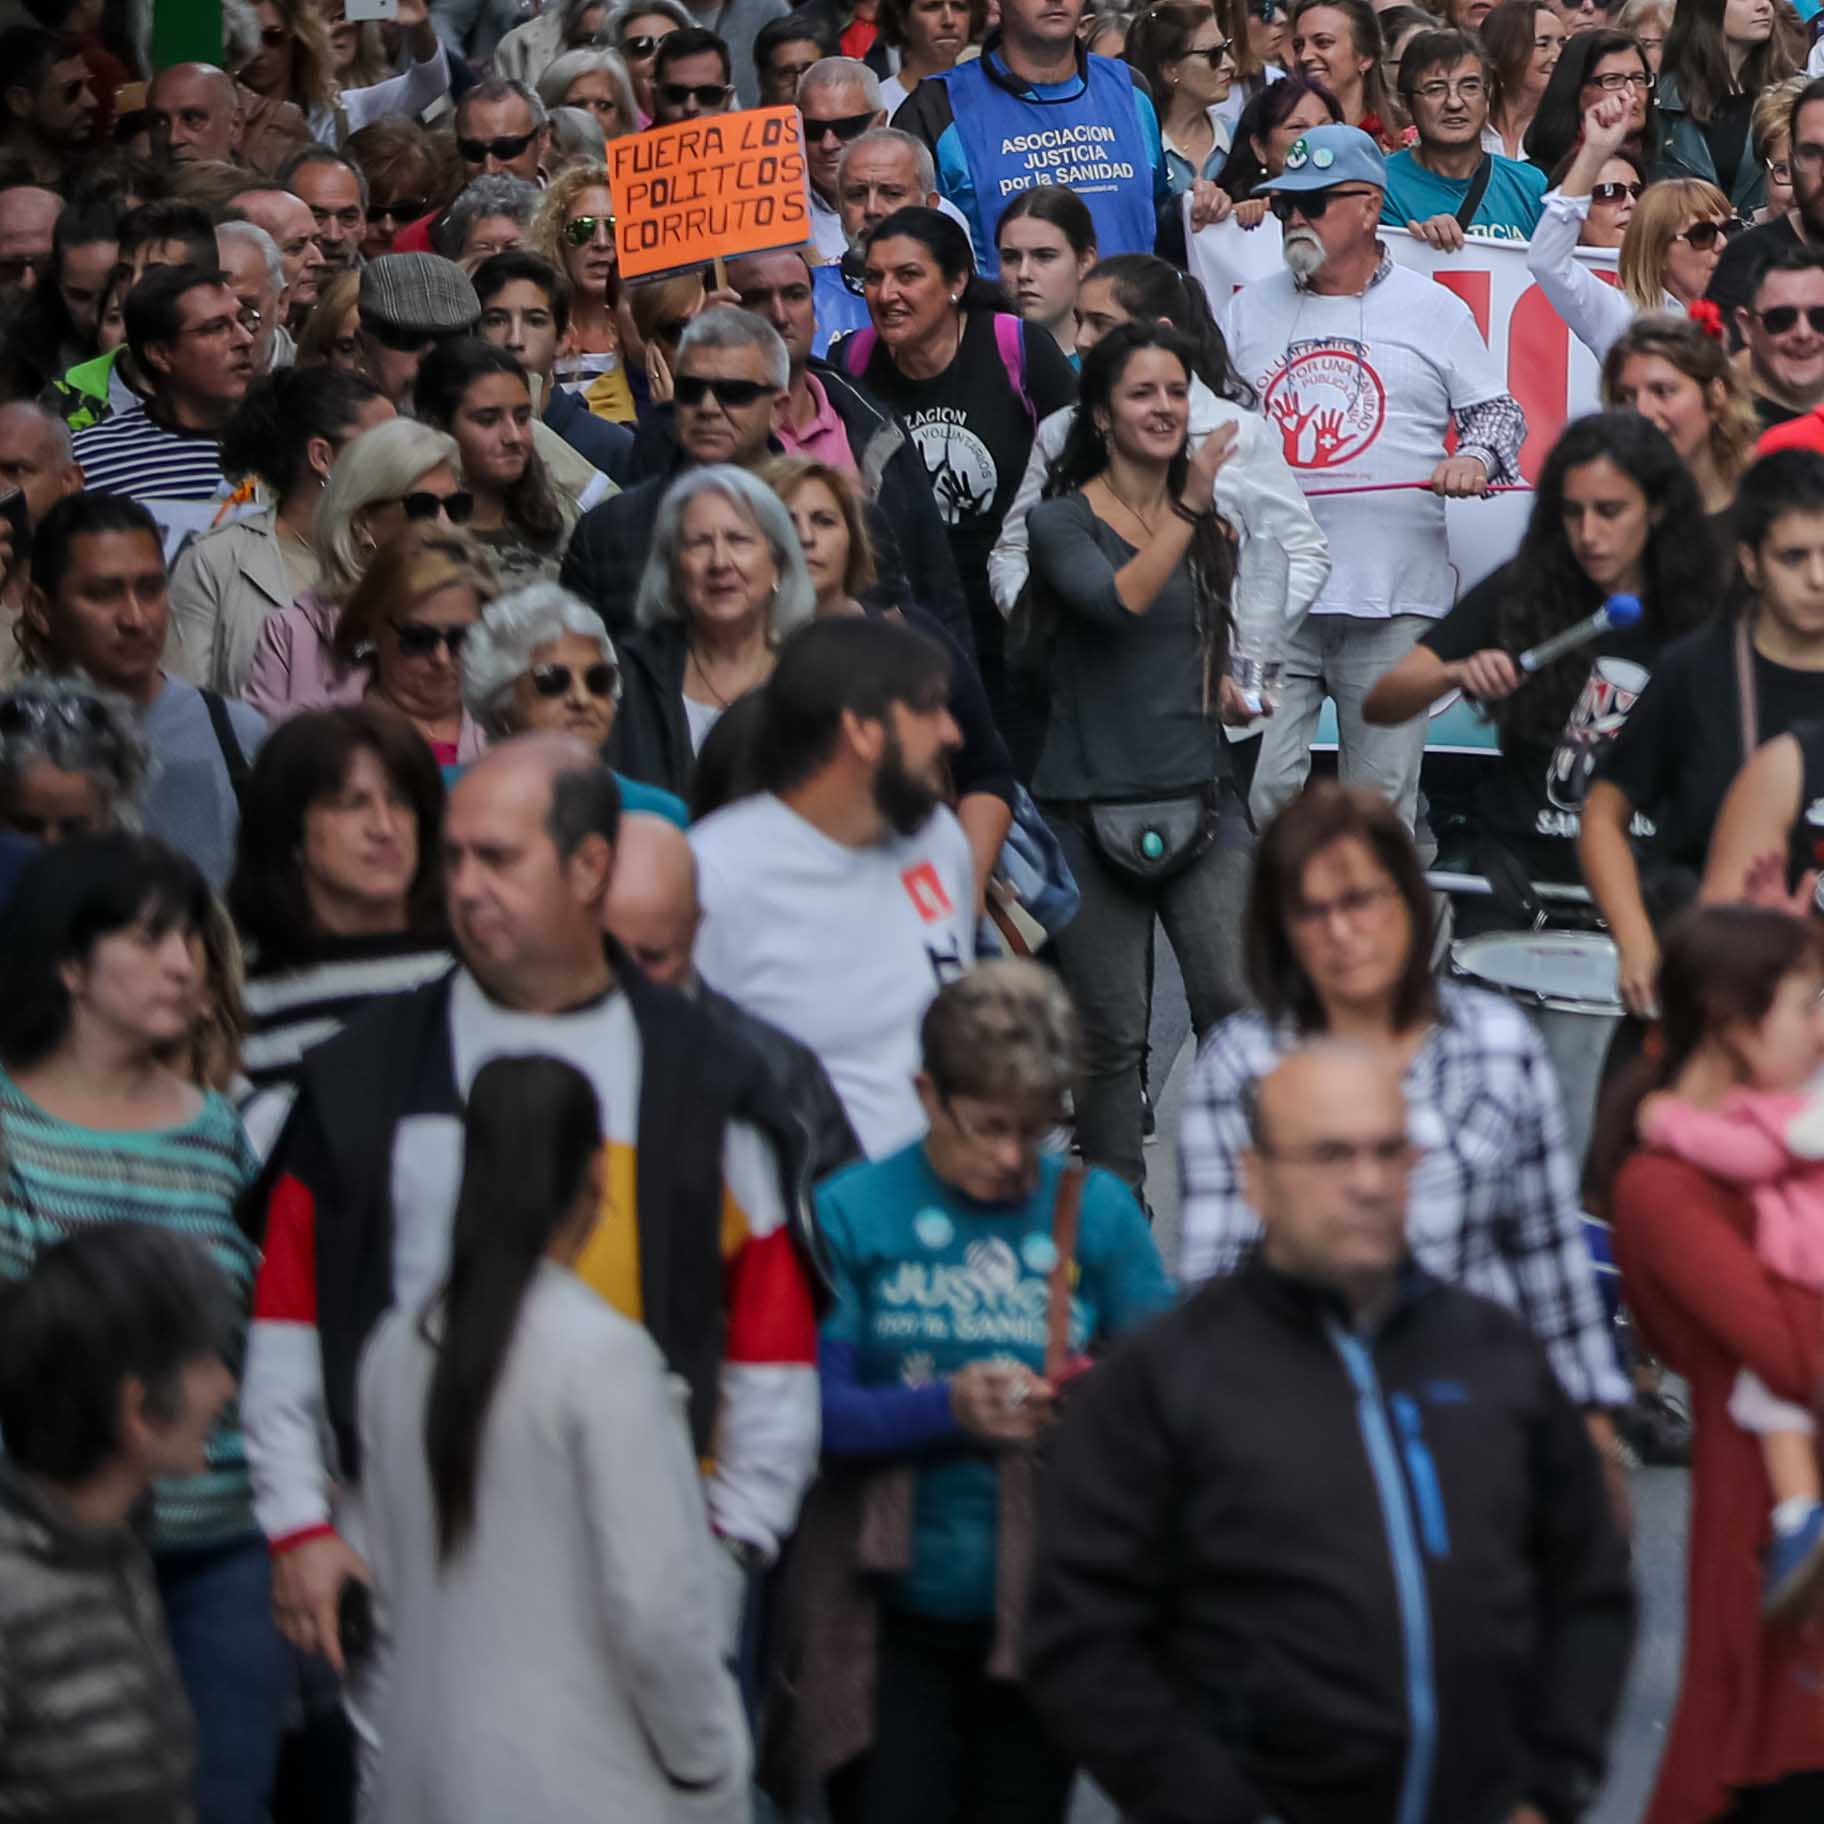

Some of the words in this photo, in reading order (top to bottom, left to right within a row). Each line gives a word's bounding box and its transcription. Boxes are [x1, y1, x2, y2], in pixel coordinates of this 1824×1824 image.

[615, 127, 724, 179] FUERA
[740, 115, 800, 151] LOS
[1001, 125, 1116, 155] ASOCIACION
[1023, 144, 1108, 169] JUSTICIA
[626, 153, 805, 215] POLITCOS
[1000, 175, 1032, 196] por
[1035, 171, 1053, 186] la
[1055, 162, 1134, 185] SANIDAD
[623, 192, 805, 253] CORRUTOS
[1321, 358, 1352, 377] UNA
